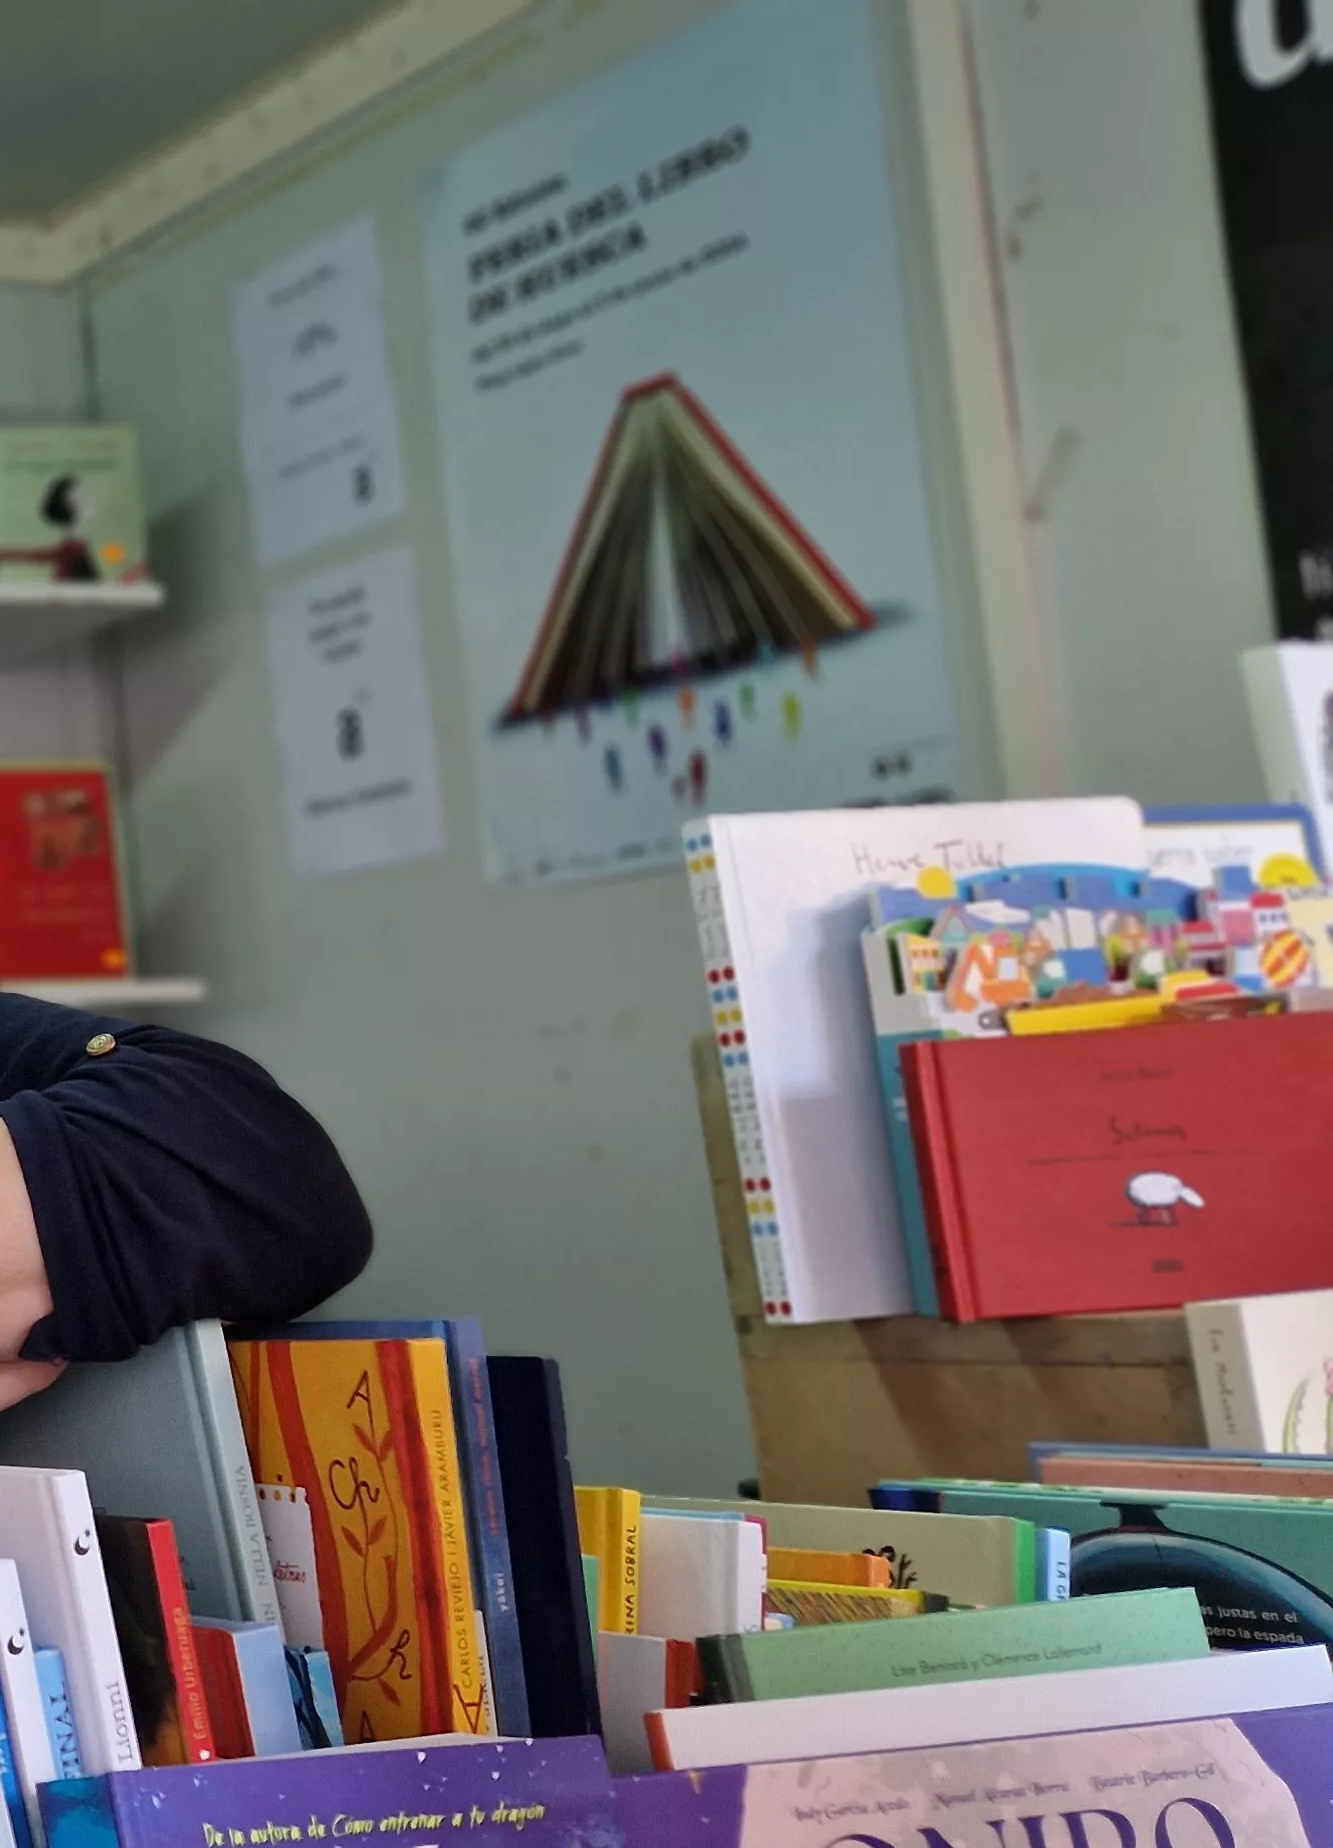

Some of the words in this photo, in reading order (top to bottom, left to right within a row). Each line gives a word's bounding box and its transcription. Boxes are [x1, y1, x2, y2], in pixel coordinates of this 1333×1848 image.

[431, 1409, 451, 1497] ARAMBURU
[441, 1499, 457, 1547] JAVIER
[246, 1531, 270, 1587] NELLA
[626, 1524, 638, 1586] SOBRAL
[1056, 1561, 1067, 1580] LA
[449, 1563, 466, 1623] REVIEJO
[1217, 1604, 1257, 1621] justas
[1261, 1610, 1280, 1623] en
[1284, 1611, 1299, 1624] el
[458, 1630, 473, 1690] CARLOS
[1238, 1626, 1251, 1640] la
[1254, 1629, 1305, 1645] espada
[104, 1681, 133, 1763] Lionni
[188, 1690, 207, 1740] Emilio
[250, 1820, 304, 1846] autora
[307, 1814, 326, 1839] de
[379, 1810, 446, 1836] entrenar
[451, 1811, 465, 1828] a
